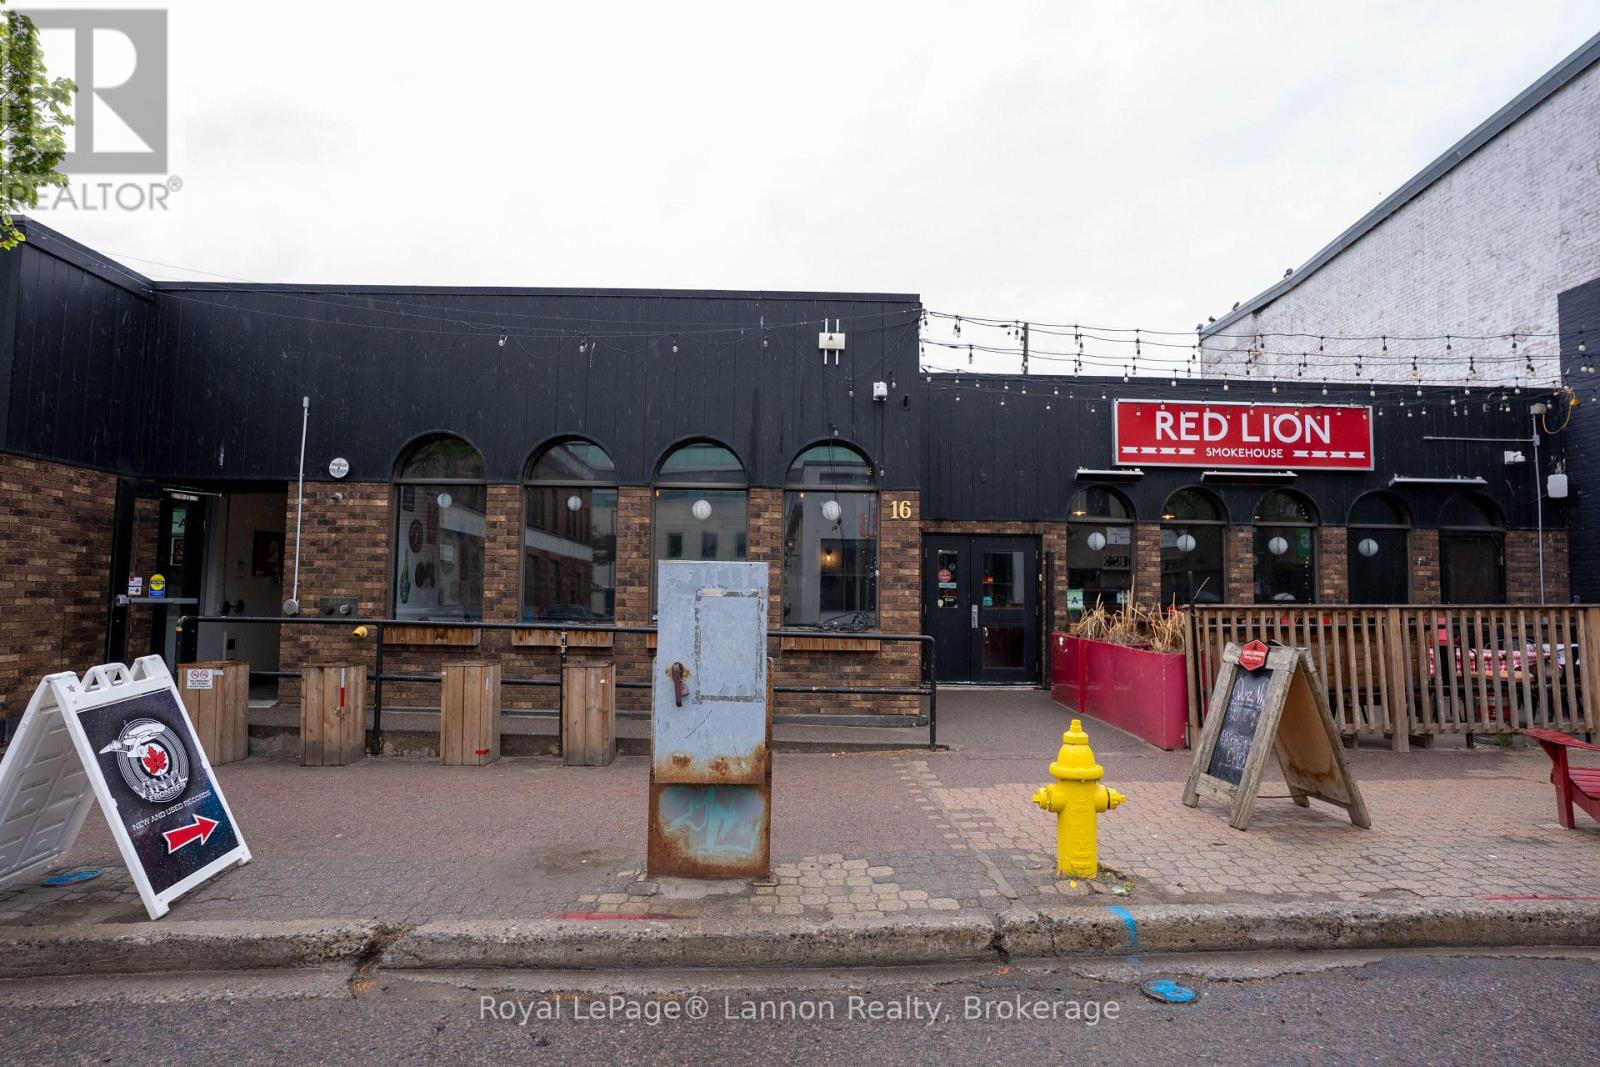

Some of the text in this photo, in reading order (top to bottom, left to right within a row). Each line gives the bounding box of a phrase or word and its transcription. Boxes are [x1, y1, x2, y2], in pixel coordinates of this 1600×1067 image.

[1155, 411, 1331, 444] RED LION
[1206, 447, 1284, 458] SMOKEHOUSE
[890, 500, 912, 519] 16
[132, 789, 212, 831] NEW AND USED RECORDS
